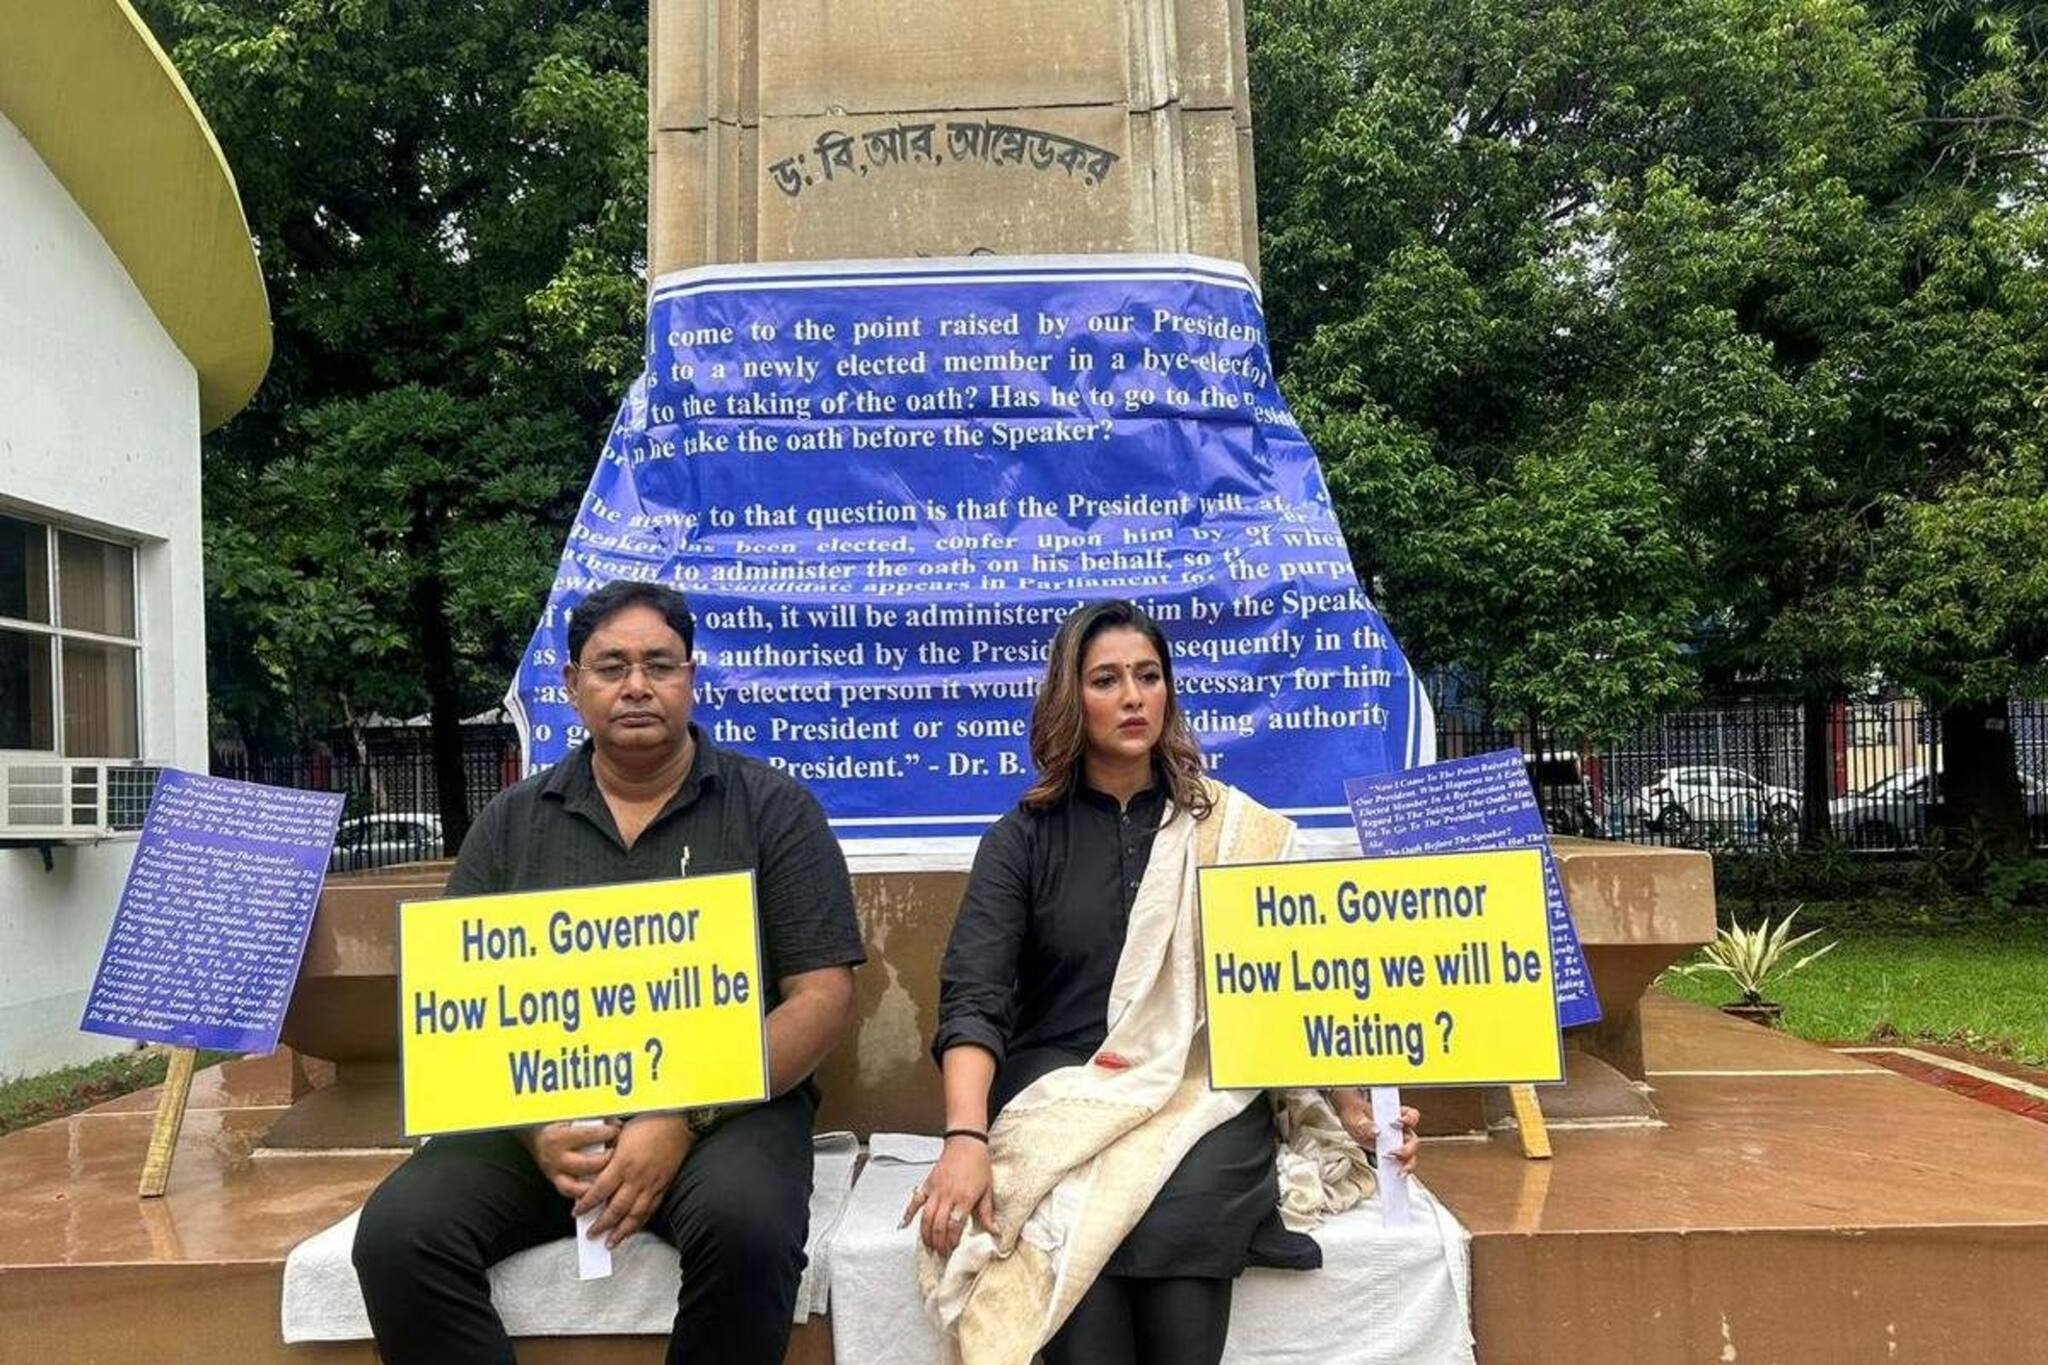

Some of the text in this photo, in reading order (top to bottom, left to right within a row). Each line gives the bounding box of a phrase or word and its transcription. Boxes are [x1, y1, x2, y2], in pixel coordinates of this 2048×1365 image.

[668, 327, 734, 347] come
[751, 320, 776, 341] to
[794, 319, 836, 341] the
[853, 316, 921, 345] point
[940, 314, 1019, 337] raised
[1038, 313, 1070, 340] by
[1088, 314, 1135, 332] our
[671, 347, 1126, 384] to a newly elected member in a
[650, 384, 1239, 424] to the taking of the oath? Has he to go to the
[736, 427, 778, 452] the
[785, 425, 844, 451] oath
[852, 424, 936, 449] before
[943, 422, 984, 447] the
[991, 419, 1114, 451] Speaker?
[709, 505, 735, 527] to
[744, 503, 798, 527] that
[806, 501, 917, 531] question
[927, 499, 948, 521] is
[956, 497, 1009, 521] that
[1018, 495, 1059, 518] the
[1067, 493, 1191, 518] President
[735, 540, 797, 553] been
[816, 536, 916, 554] elected,
[935, 533, 1019, 551] confer
[1037, 532, 1102, 553] upon
[1123, 527, 1173, 545] him
[1191, 529, 1223, 544] by
[675, 562, 700, 581] to
[711, 560, 857, 582] administer
[867, 559, 909, 578] the
[918, 557, 977, 576] oath
[987, 558, 1019, 573] on
[1031, 553, 1070, 573] his
[1081, 548, 1173, 572] behalf,
[1182, 552, 1212, 568] so
[1228, 558, 1271, 581] the
[980, 575, 1006, 590] in
[1018, 573, 1169, 591] Parliament
[705, 604, 774, 632] oath,
[781, 603, 800, 628] it
[808, 602, 857, 628] will
[866, 600, 898, 627] be
[1191, 597, 1225, 624] by
[1233, 594, 1275, 618] the
[719, 641, 865, 668] authorised
[875, 641, 907, 671] by
[919, 640, 961, 663] the
[1314, 627, 1342, 651] in
[1352, 625, 1389, 650] the
[737, 680, 831, 704] elected
[841, 680, 932, 708] person
[942, 678, 961, 699] it
[1294, 667, 1336, 690] for
[1343, 664, 1391, 688] him
[714, 719, 757, 743] the
[771, 717, 900, 742] President
[913, 720, 943, 738] or
[956, 718, 1026, 737] some
[1268, 703, 1390, 731] authority
[946, 751, 989, 776] Dr.
[999, 750, 1027, 775] B.
[1392, 797, 1428, 811] Member
[1255, 880, 1487, 927] Hon. Governor
[463, 908, 700, 962] Hon. Governor
[1215, 940, 1542, 1001] How Long we will be
[415, 963, 750, 1035] How Long we will be
[1303, 1010, 1454, 1067] Waiting ?
[508, 1037, 664, 1096] Waiting ?
